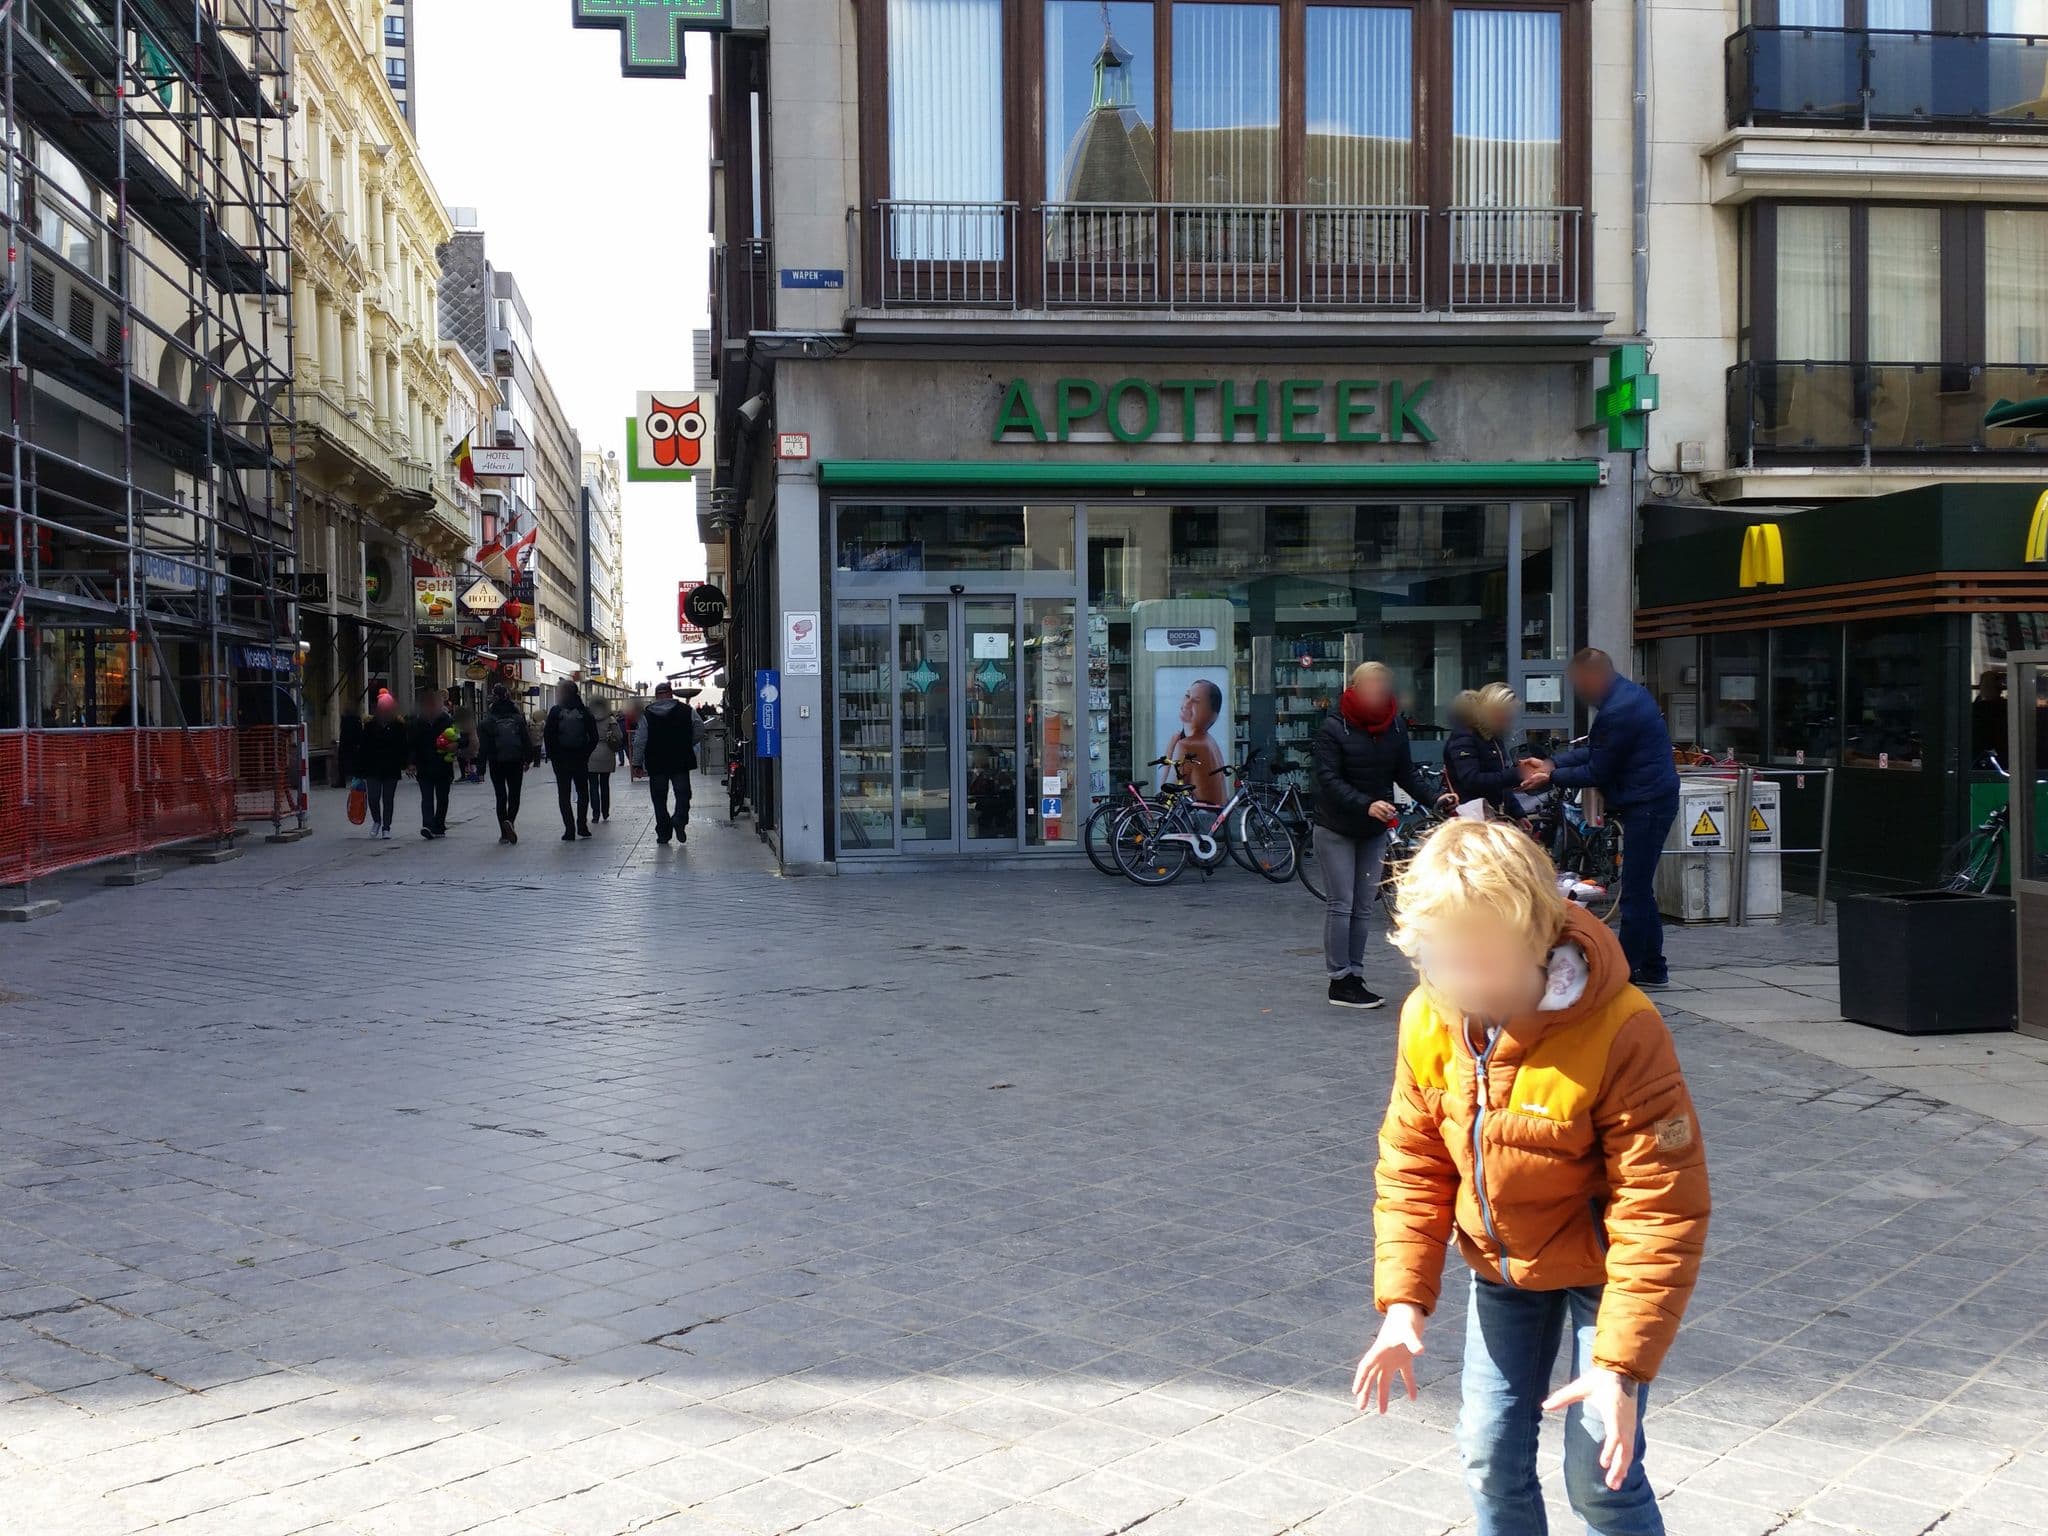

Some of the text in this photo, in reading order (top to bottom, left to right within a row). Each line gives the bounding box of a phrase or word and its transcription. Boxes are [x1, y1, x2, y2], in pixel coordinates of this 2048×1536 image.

[792, 270, 824, 280] WAPEN-
[824, 280, 839, 288] PLEIN
[992, 377, 1439, 442] APOTHEEK
[486, 451, 510, 460] HOTEL
[482, 461, 506, 470] Albert
[416, 579, 454, 592] Selfi
[480, 584, 488, 594] A
[468, 594, 499, 603] HOTEL
[693, 595, 726, 613] ferm
